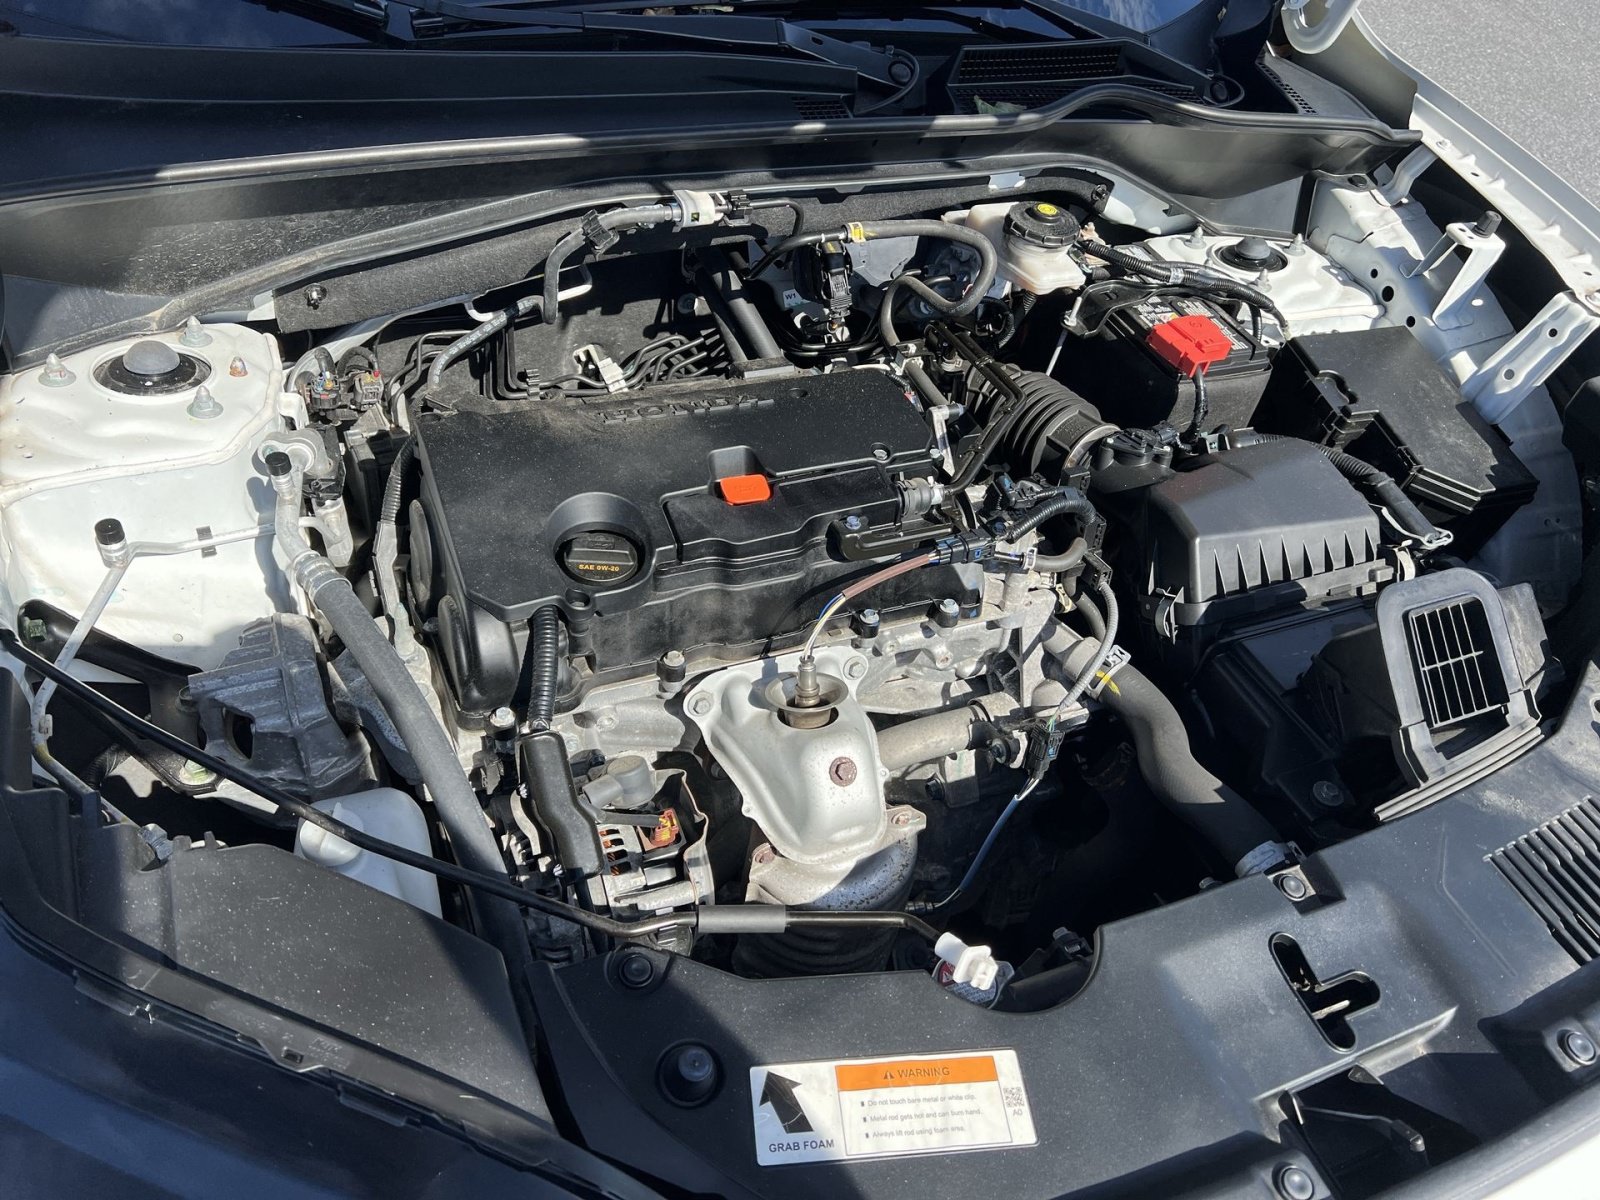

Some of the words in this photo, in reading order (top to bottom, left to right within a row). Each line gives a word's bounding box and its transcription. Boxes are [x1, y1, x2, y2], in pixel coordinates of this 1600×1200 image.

[596, 564, 620, 572] 0W-20
[898, 1066, 950, 1078] WARNING
[868, 1099, 877, 1107] Do
[923, 1095, 938, 1103] metal
[900, 1114, 913, 1122] gets
[951, 1109, 964, 1117] burn
[873, 1130, 894, 1139] Always
[916, 1127, 932, 1135] using
[768, 1141, 801, 1153] GRAB
[803, 1139, 835, 1150] FOAM
